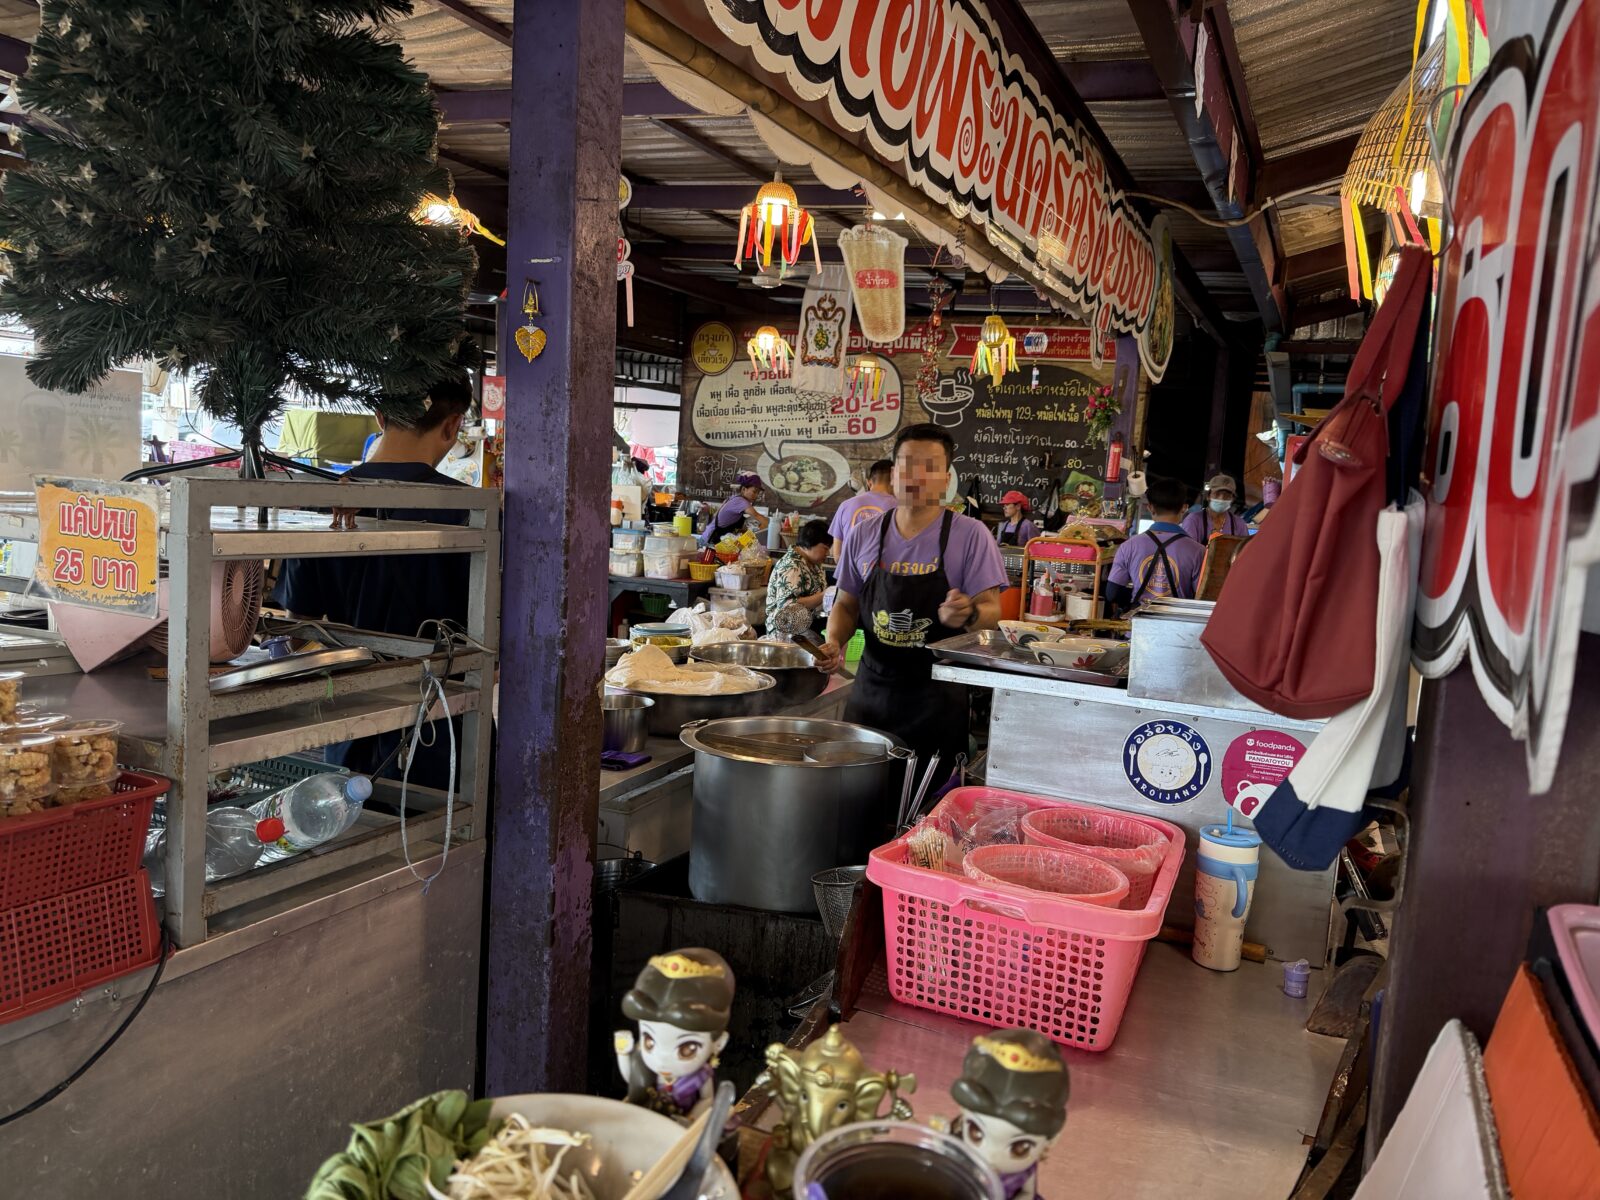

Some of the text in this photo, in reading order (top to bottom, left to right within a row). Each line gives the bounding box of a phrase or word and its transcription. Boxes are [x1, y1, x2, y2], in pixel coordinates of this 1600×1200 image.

[726, 384, 739, 398] เนื้อ
[797, 428, 812, 438] หมู
[54, 549, 138, 592] 25 บาท
[1256, 740, 1296, 752] foodpanda
[1248, 756, 1291, 766] PANDATOYOU
[1133, 777, 1198, 801] AROIJANG
